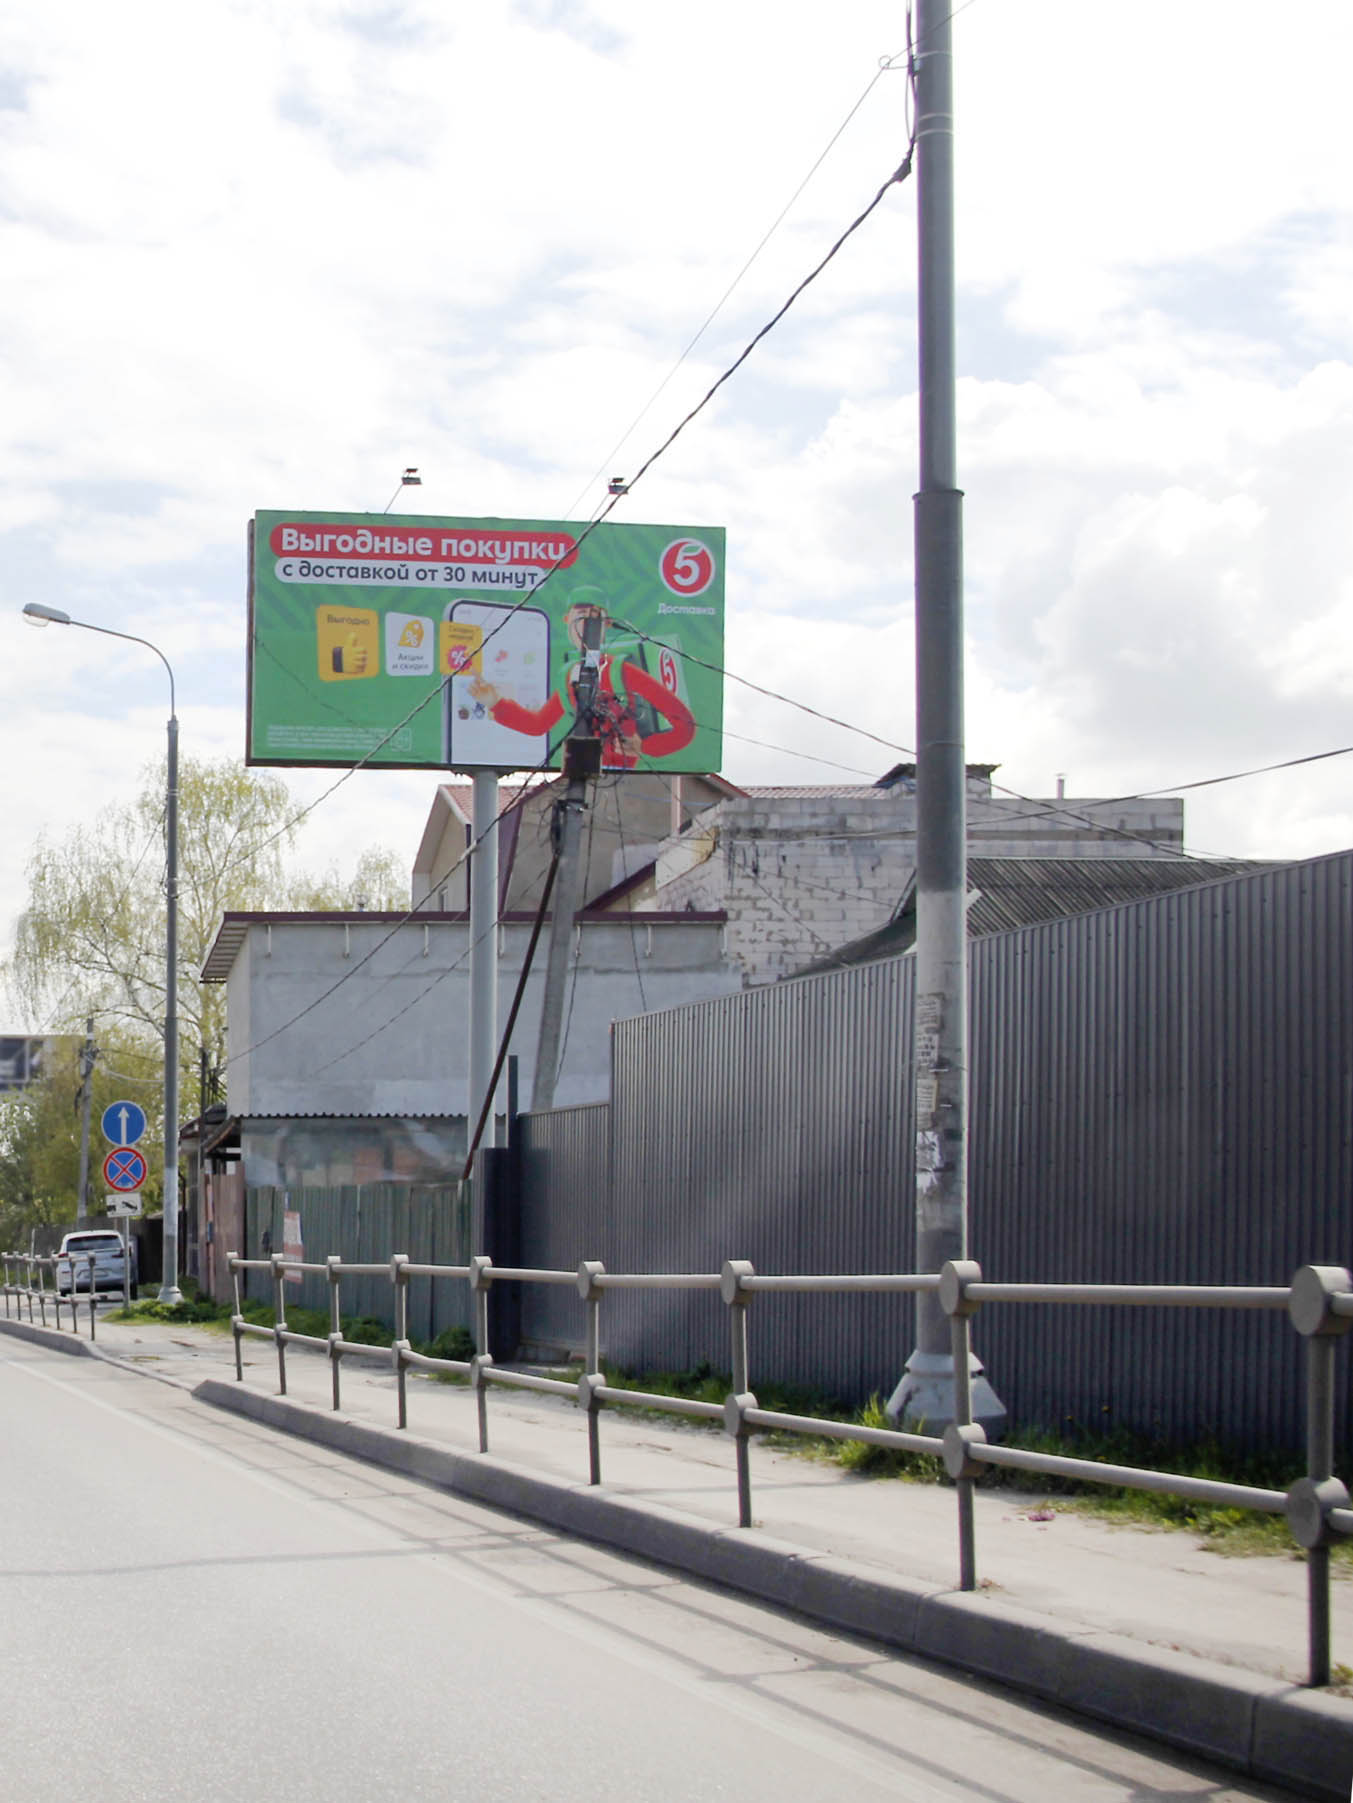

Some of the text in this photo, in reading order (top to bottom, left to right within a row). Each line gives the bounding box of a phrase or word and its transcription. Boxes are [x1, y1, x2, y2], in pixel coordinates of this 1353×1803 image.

[282, 528, 567, 564] Выгодные покупки
[282, 561, 538, 588] с доставкой от 30 минут
[657, 603, 716, 615] Доставка
[327, 614, 370, 626] Выгодно
